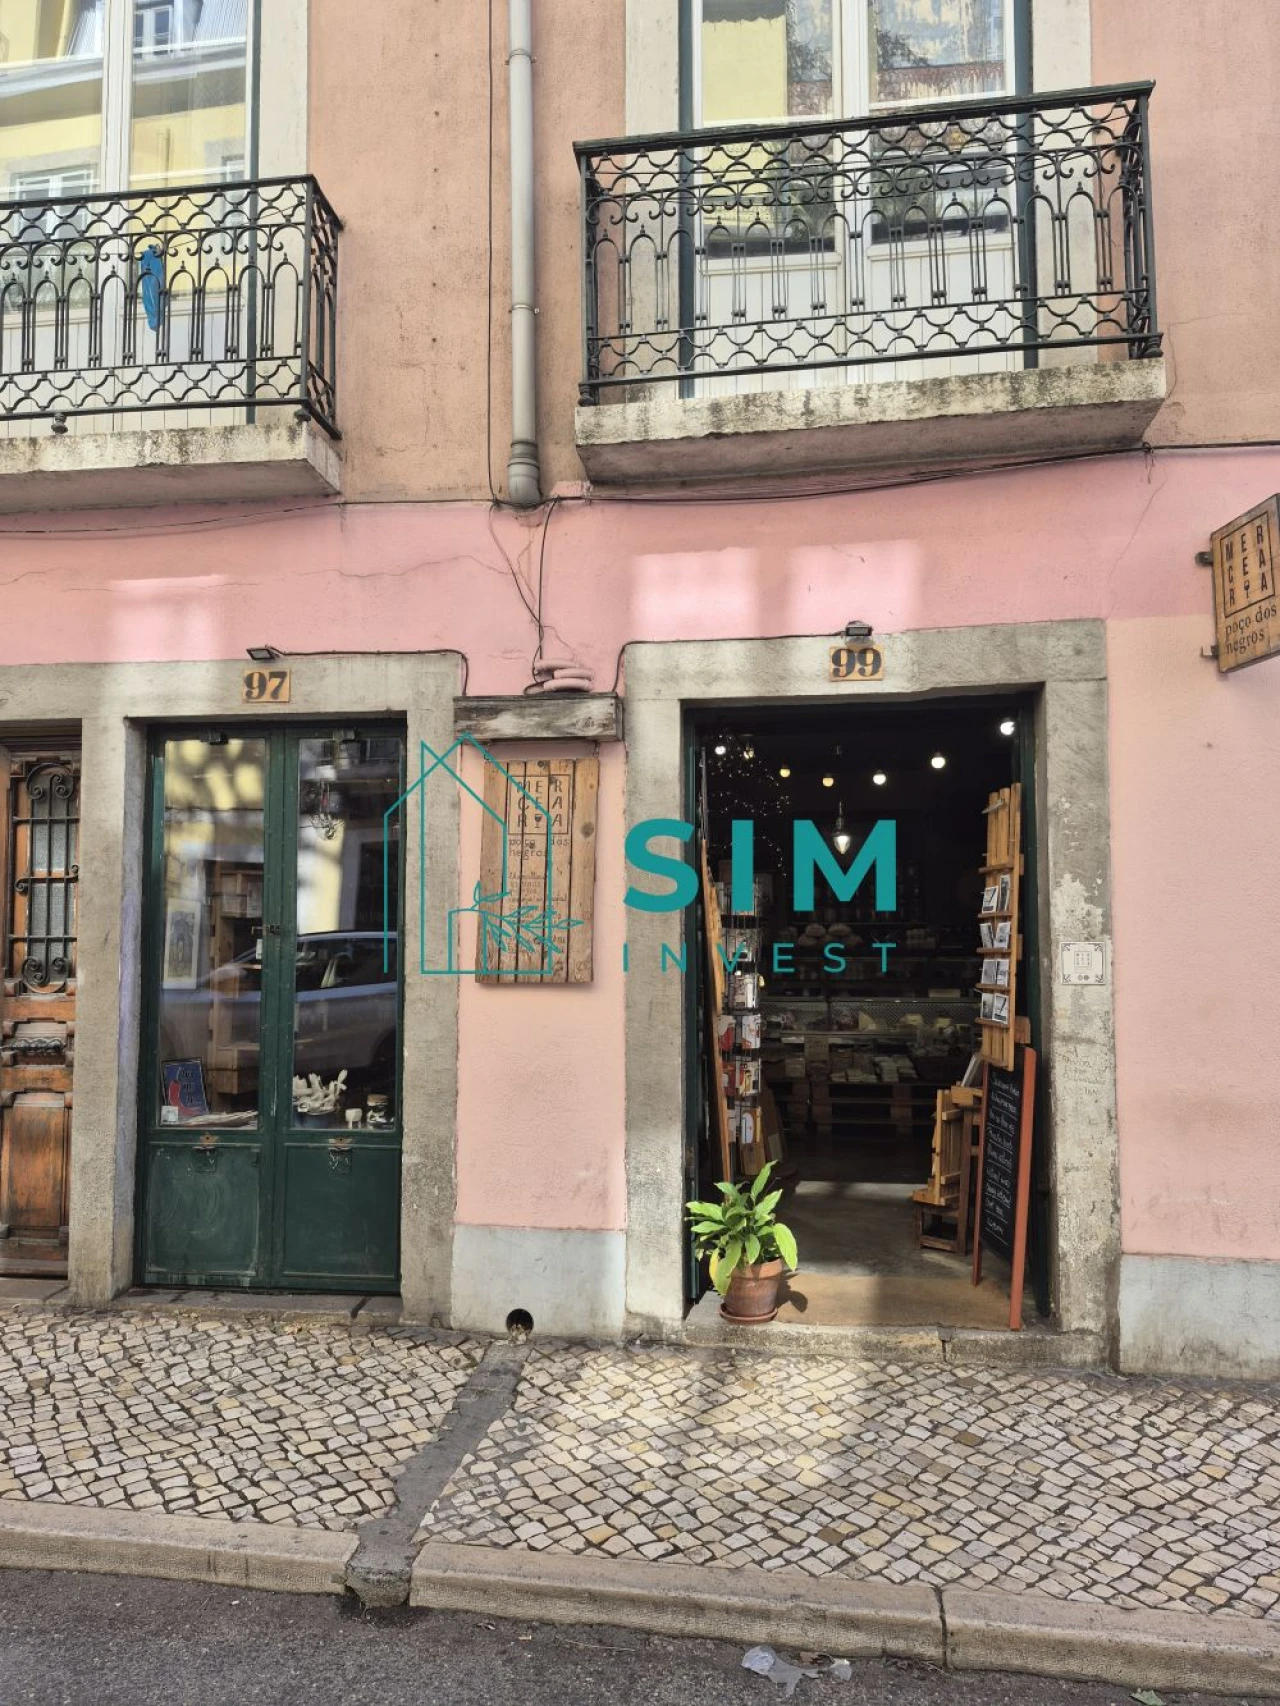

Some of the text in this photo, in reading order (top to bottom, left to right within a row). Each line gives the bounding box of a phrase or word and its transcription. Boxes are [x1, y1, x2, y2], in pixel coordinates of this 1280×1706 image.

[1256, 604, 1277, 623] dos
[1226, 629, 1265, 654] negros
[831, 648, 882, 677] 99
[244, 671, 288, 700] 97
